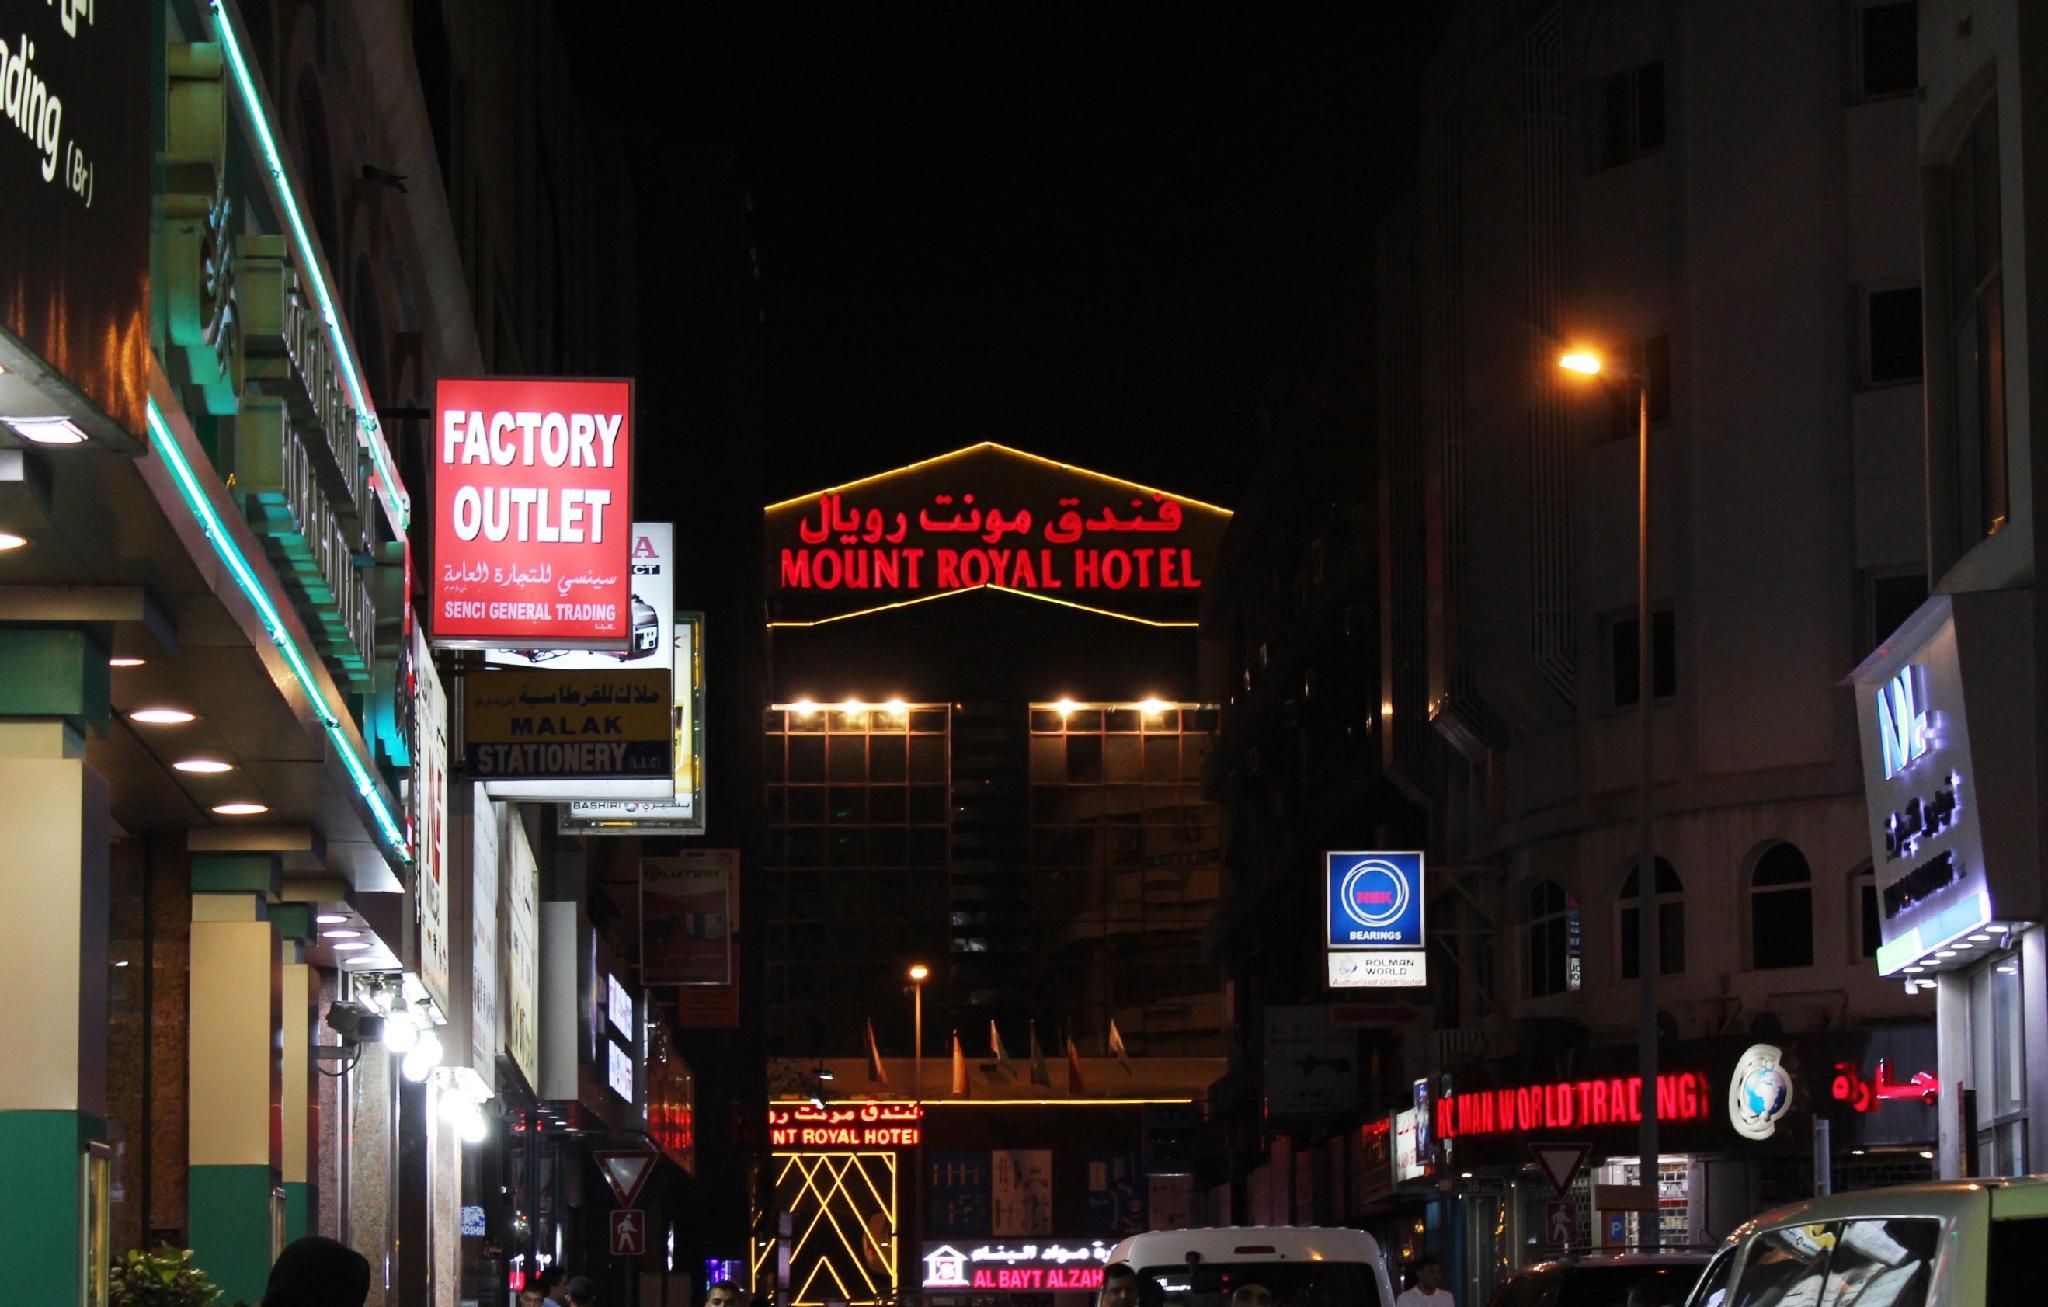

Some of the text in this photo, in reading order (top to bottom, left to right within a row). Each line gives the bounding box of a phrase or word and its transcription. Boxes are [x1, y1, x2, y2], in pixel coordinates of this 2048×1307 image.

[66, 140, 94, 208] (Br)
[443, 410, 622, 467] FACTORY
[453, 486, 610, 543] OUTLET
[800, 492, 1183, 544] فندق مونت رويال
[444, 560, 617, 597] سينسي للتجارة العامة
[781, 547, 1202, 590] MOUNT ROYAL HOTEL
[444, 600, 617, 621] SENCI GENERAL TRADING
[510, 716, 623, 736] MALAK
[477, 743, 628, 774] STATIONERY
[573, 801, 621, 809] BASHIRI
[1349, 930, 1402, 941] BEARINGS
[1365, 959, 1414, 967] ROLMAN
[1366, 967, 1407, 975] WORLD
[1499, 1082, 1574, 1132] WORLD
[1577, 1072, 1697, 1126] TRADNG
[801, 1127, 860, 1145] ROYAL
[1610, 1222, 1622, 1237] P
[973, 1269, 997, 1289] AL
[999, 1269, 1045, 1289] BAYT
